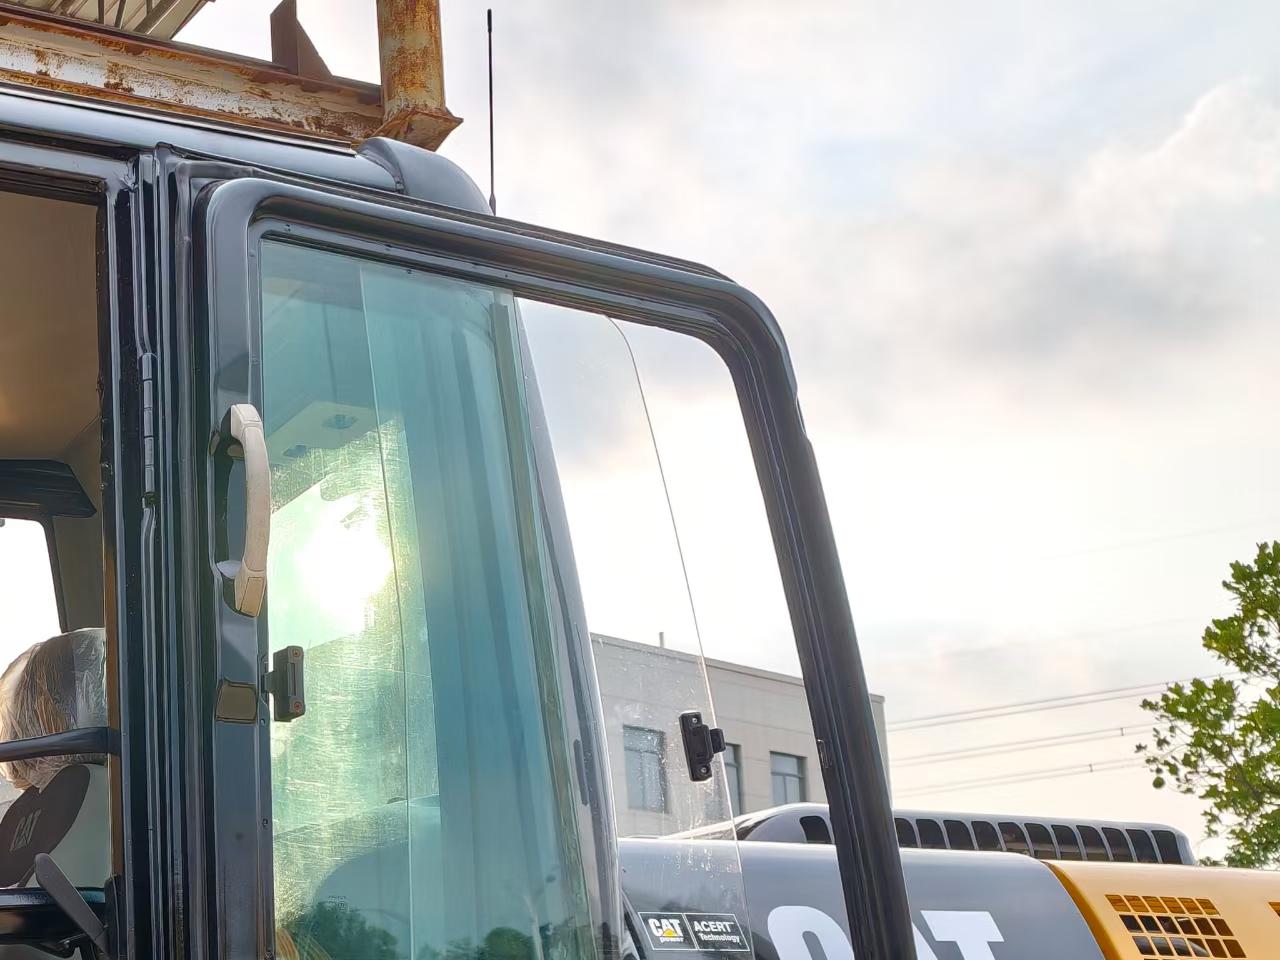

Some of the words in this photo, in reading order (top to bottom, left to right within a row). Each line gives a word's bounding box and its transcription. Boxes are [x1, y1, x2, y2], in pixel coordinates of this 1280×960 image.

[648, 919, 683, 936] CAT
[693, 921, 732, 932] ACERT
[699, 933, 741, 944] Technology
